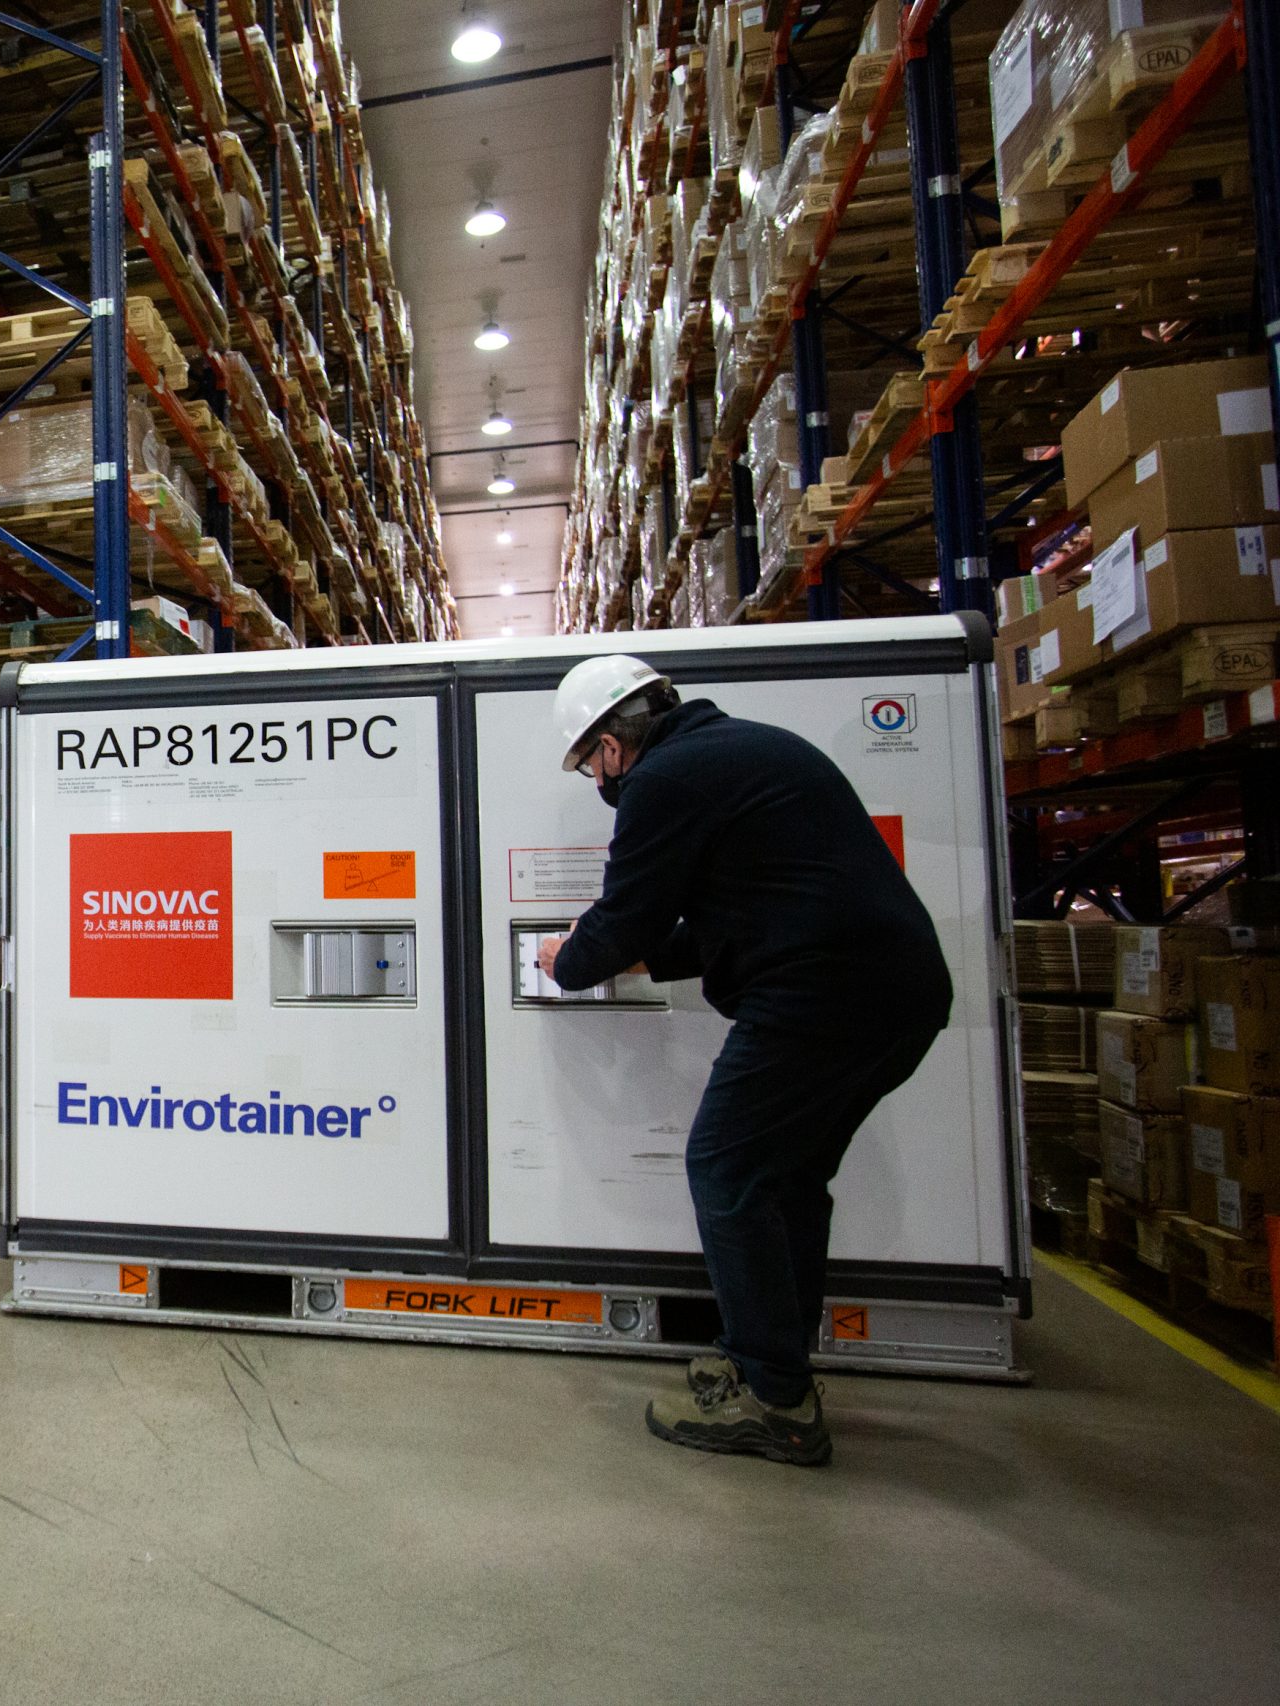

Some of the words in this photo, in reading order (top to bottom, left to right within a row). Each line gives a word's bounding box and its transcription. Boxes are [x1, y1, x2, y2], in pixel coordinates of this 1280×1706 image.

[1146, 49, 1185, 69] EPAL
[1221, 653, 1263, 670] EPAL
[57, 715, 398, 771] RAP81251PC
[82, 890, 219, 915] SINOVAC
[83, 919, 219, 932] 为人类消除疾病提供疫苗
[385, 1290, 474, 1313] FORK
[489, 1296, 561, 1318] LIFT
